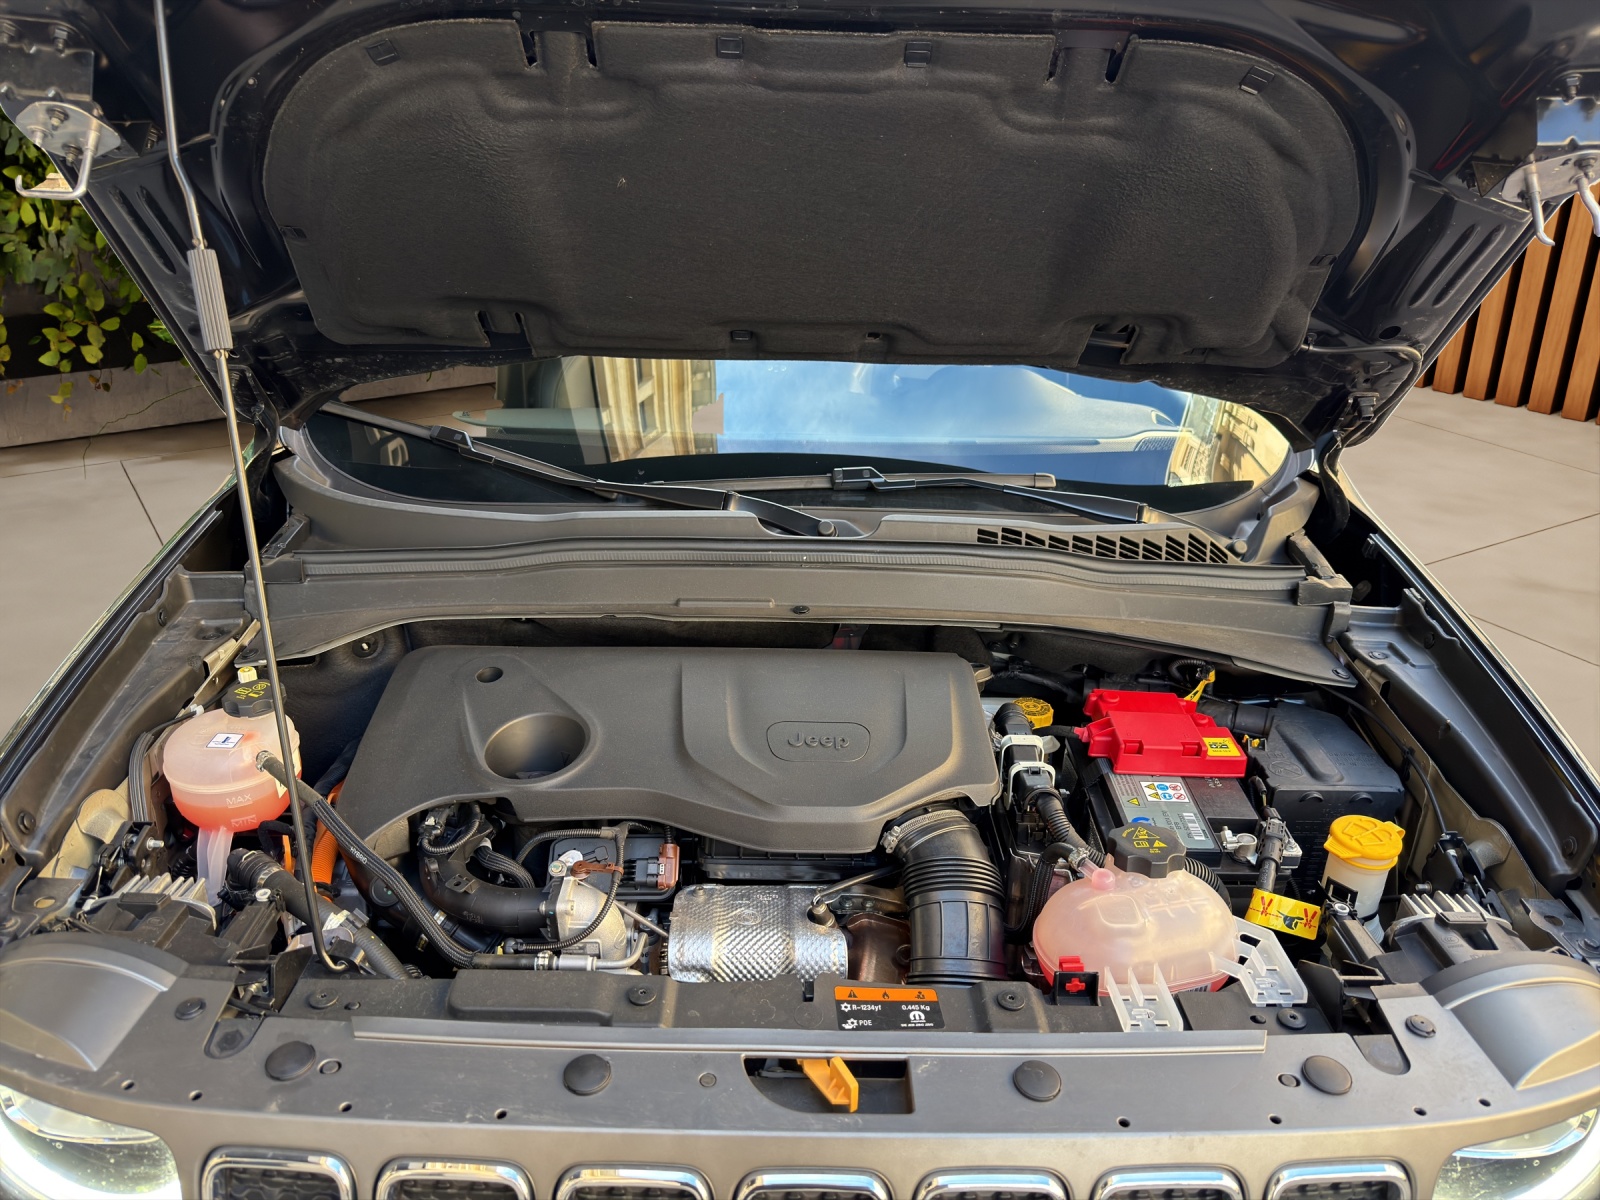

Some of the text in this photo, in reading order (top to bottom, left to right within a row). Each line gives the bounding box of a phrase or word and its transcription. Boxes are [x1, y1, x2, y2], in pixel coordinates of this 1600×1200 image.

[788, 732, 850, 751] Jeep
[226, 793, 252, 805] MAX
[231, 816, 257, 828] MIN
[350, 846, 368, 865] HYBRID
